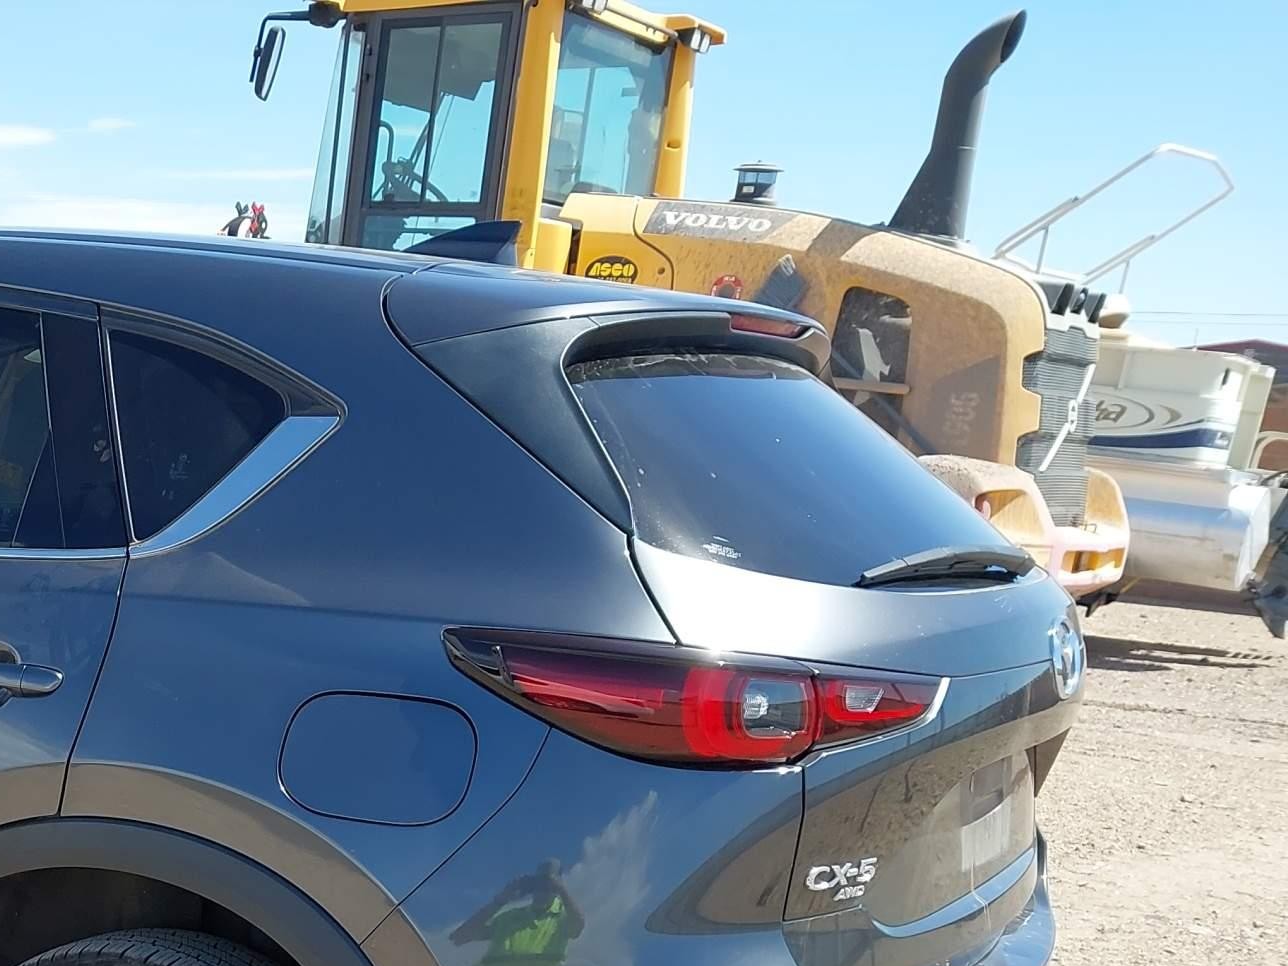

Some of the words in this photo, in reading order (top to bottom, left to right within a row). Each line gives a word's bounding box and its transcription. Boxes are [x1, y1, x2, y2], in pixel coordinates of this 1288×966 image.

[663, 210, 772, 232] VOLVO
[806, 857, 878, 891] CX-5
[833, 885, 865, 901] AWD
